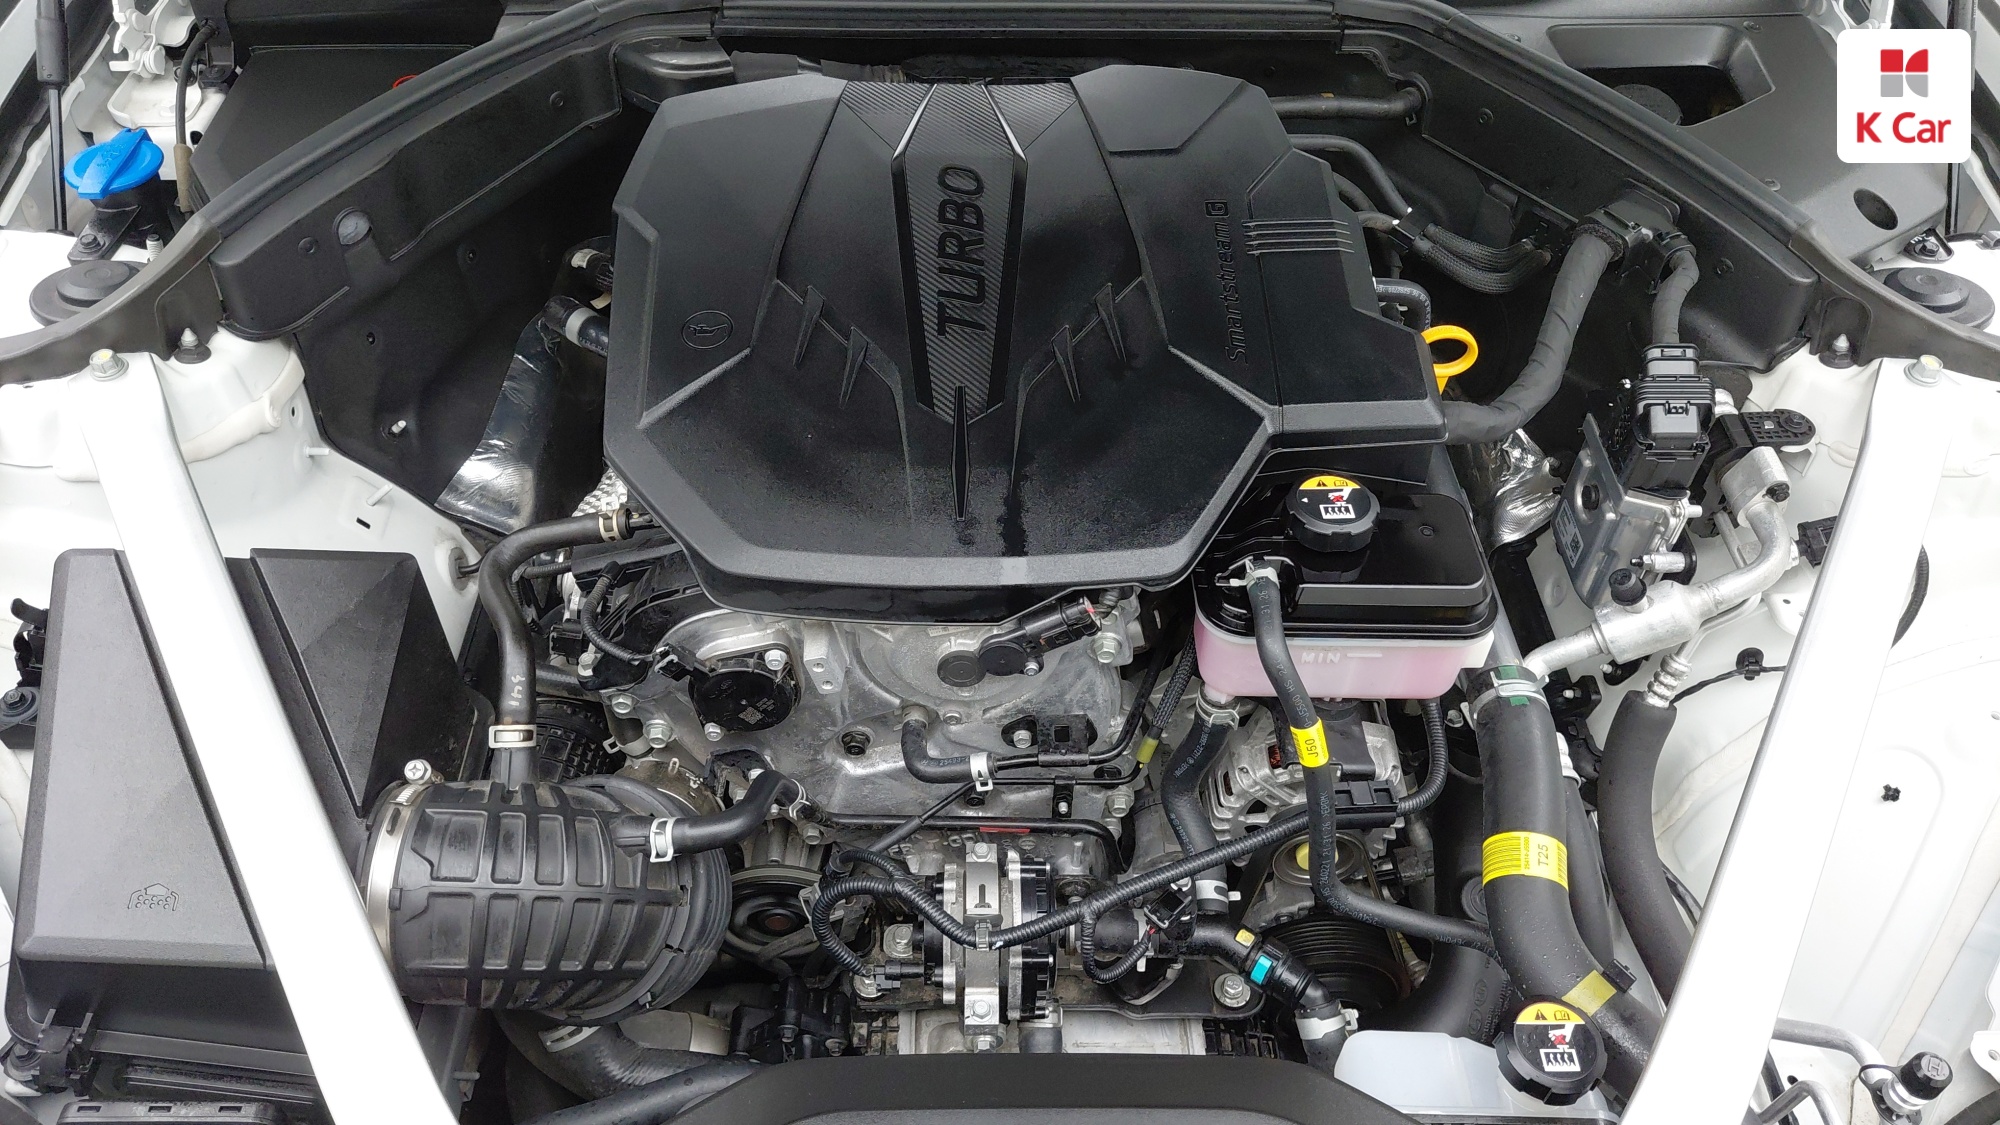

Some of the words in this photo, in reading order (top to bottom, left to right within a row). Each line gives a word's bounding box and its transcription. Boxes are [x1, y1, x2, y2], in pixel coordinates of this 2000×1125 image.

[937, 163, 986, 337] TURBO
[1214, 221, 1249, 365] Smartstream
[1301, 652, 1340, 663] MIN
[1304, 738, 1319, 758] J50
[1538, 844, 1549, 866] T25
